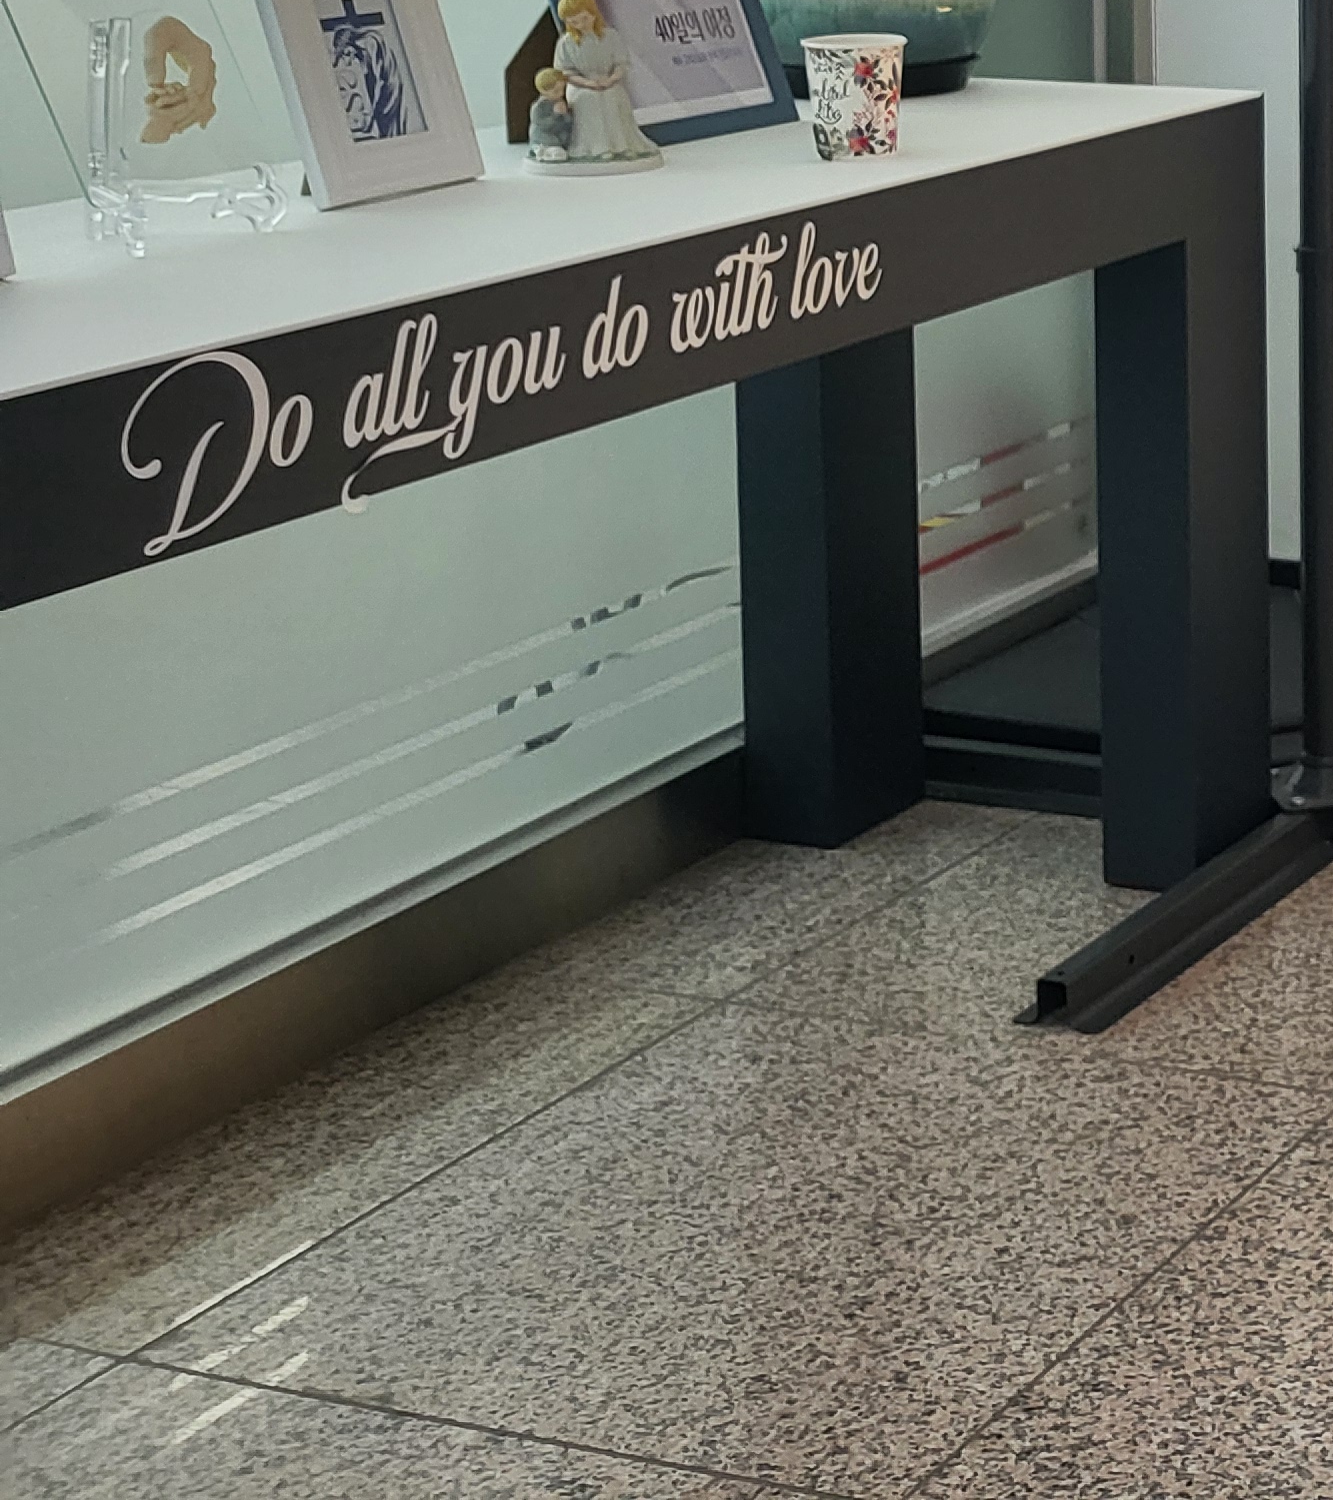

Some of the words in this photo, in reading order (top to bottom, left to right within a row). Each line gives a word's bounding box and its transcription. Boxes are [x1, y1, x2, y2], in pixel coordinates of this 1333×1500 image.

[583, 276, 650, 379] do
[670, 231, 788, 355] with
[789, 220, 883, 325] love
[341, 324, 567, 514] you
[343, 313, 439, 452] all
[120, 349, 313, 557] Do
